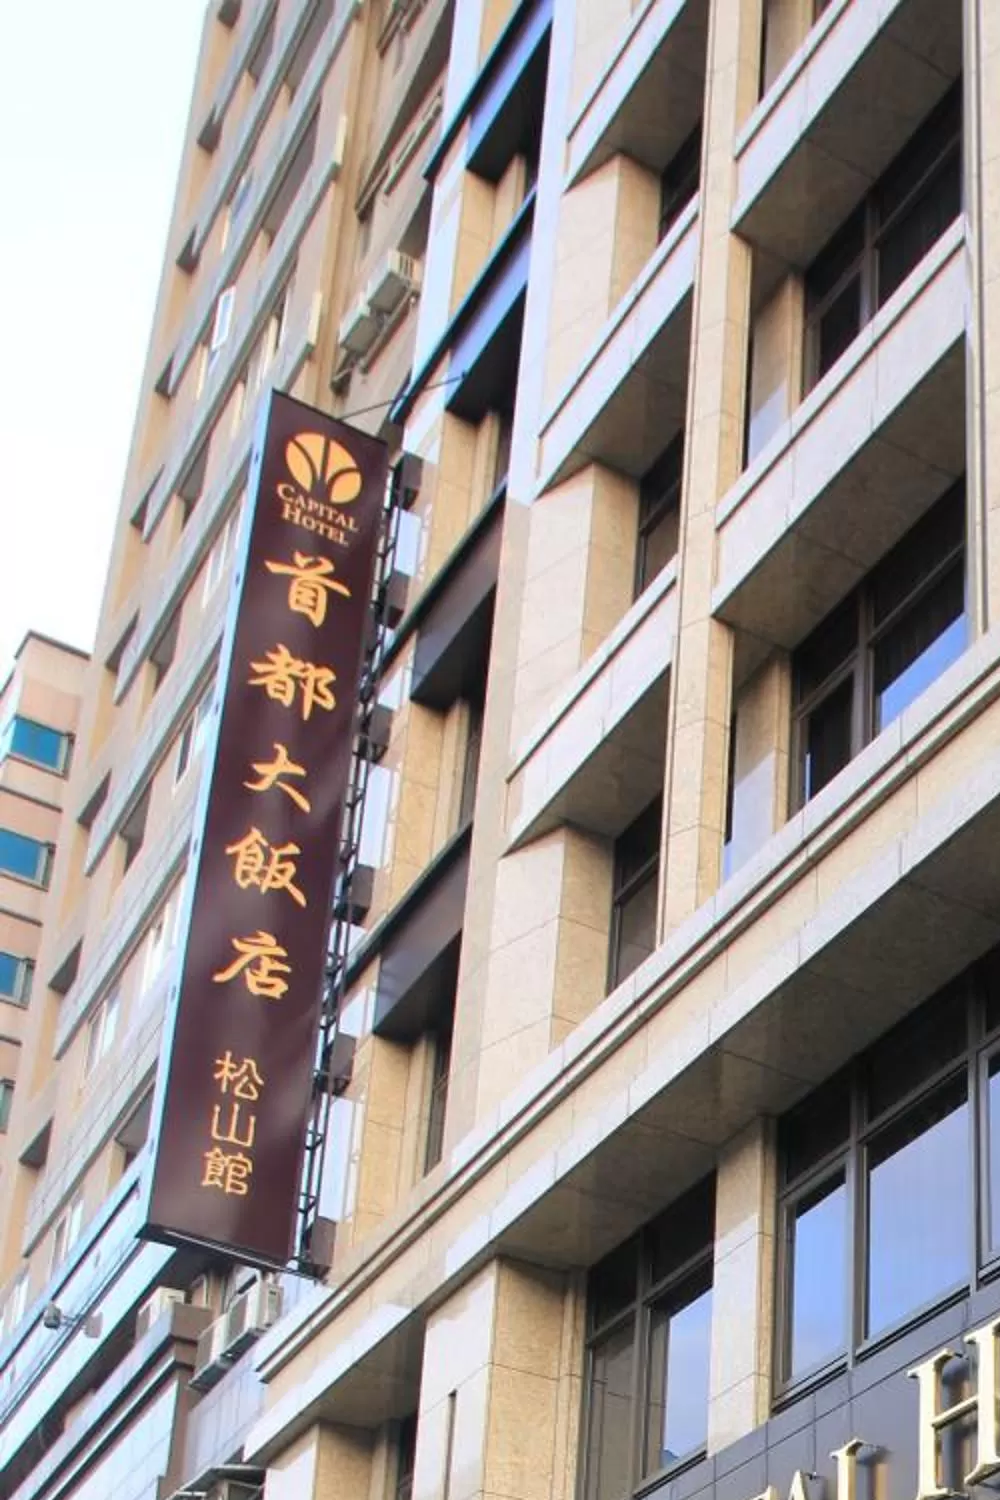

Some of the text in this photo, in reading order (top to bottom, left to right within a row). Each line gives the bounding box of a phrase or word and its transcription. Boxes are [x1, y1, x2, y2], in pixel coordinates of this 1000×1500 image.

[277, 483, 359, 532] CAPITAL
[282, 502, 349, 547] HOTEL
[212, 551, 352, 999] 首都大飯店
[201, 1050, 265, 1196] 松山館
